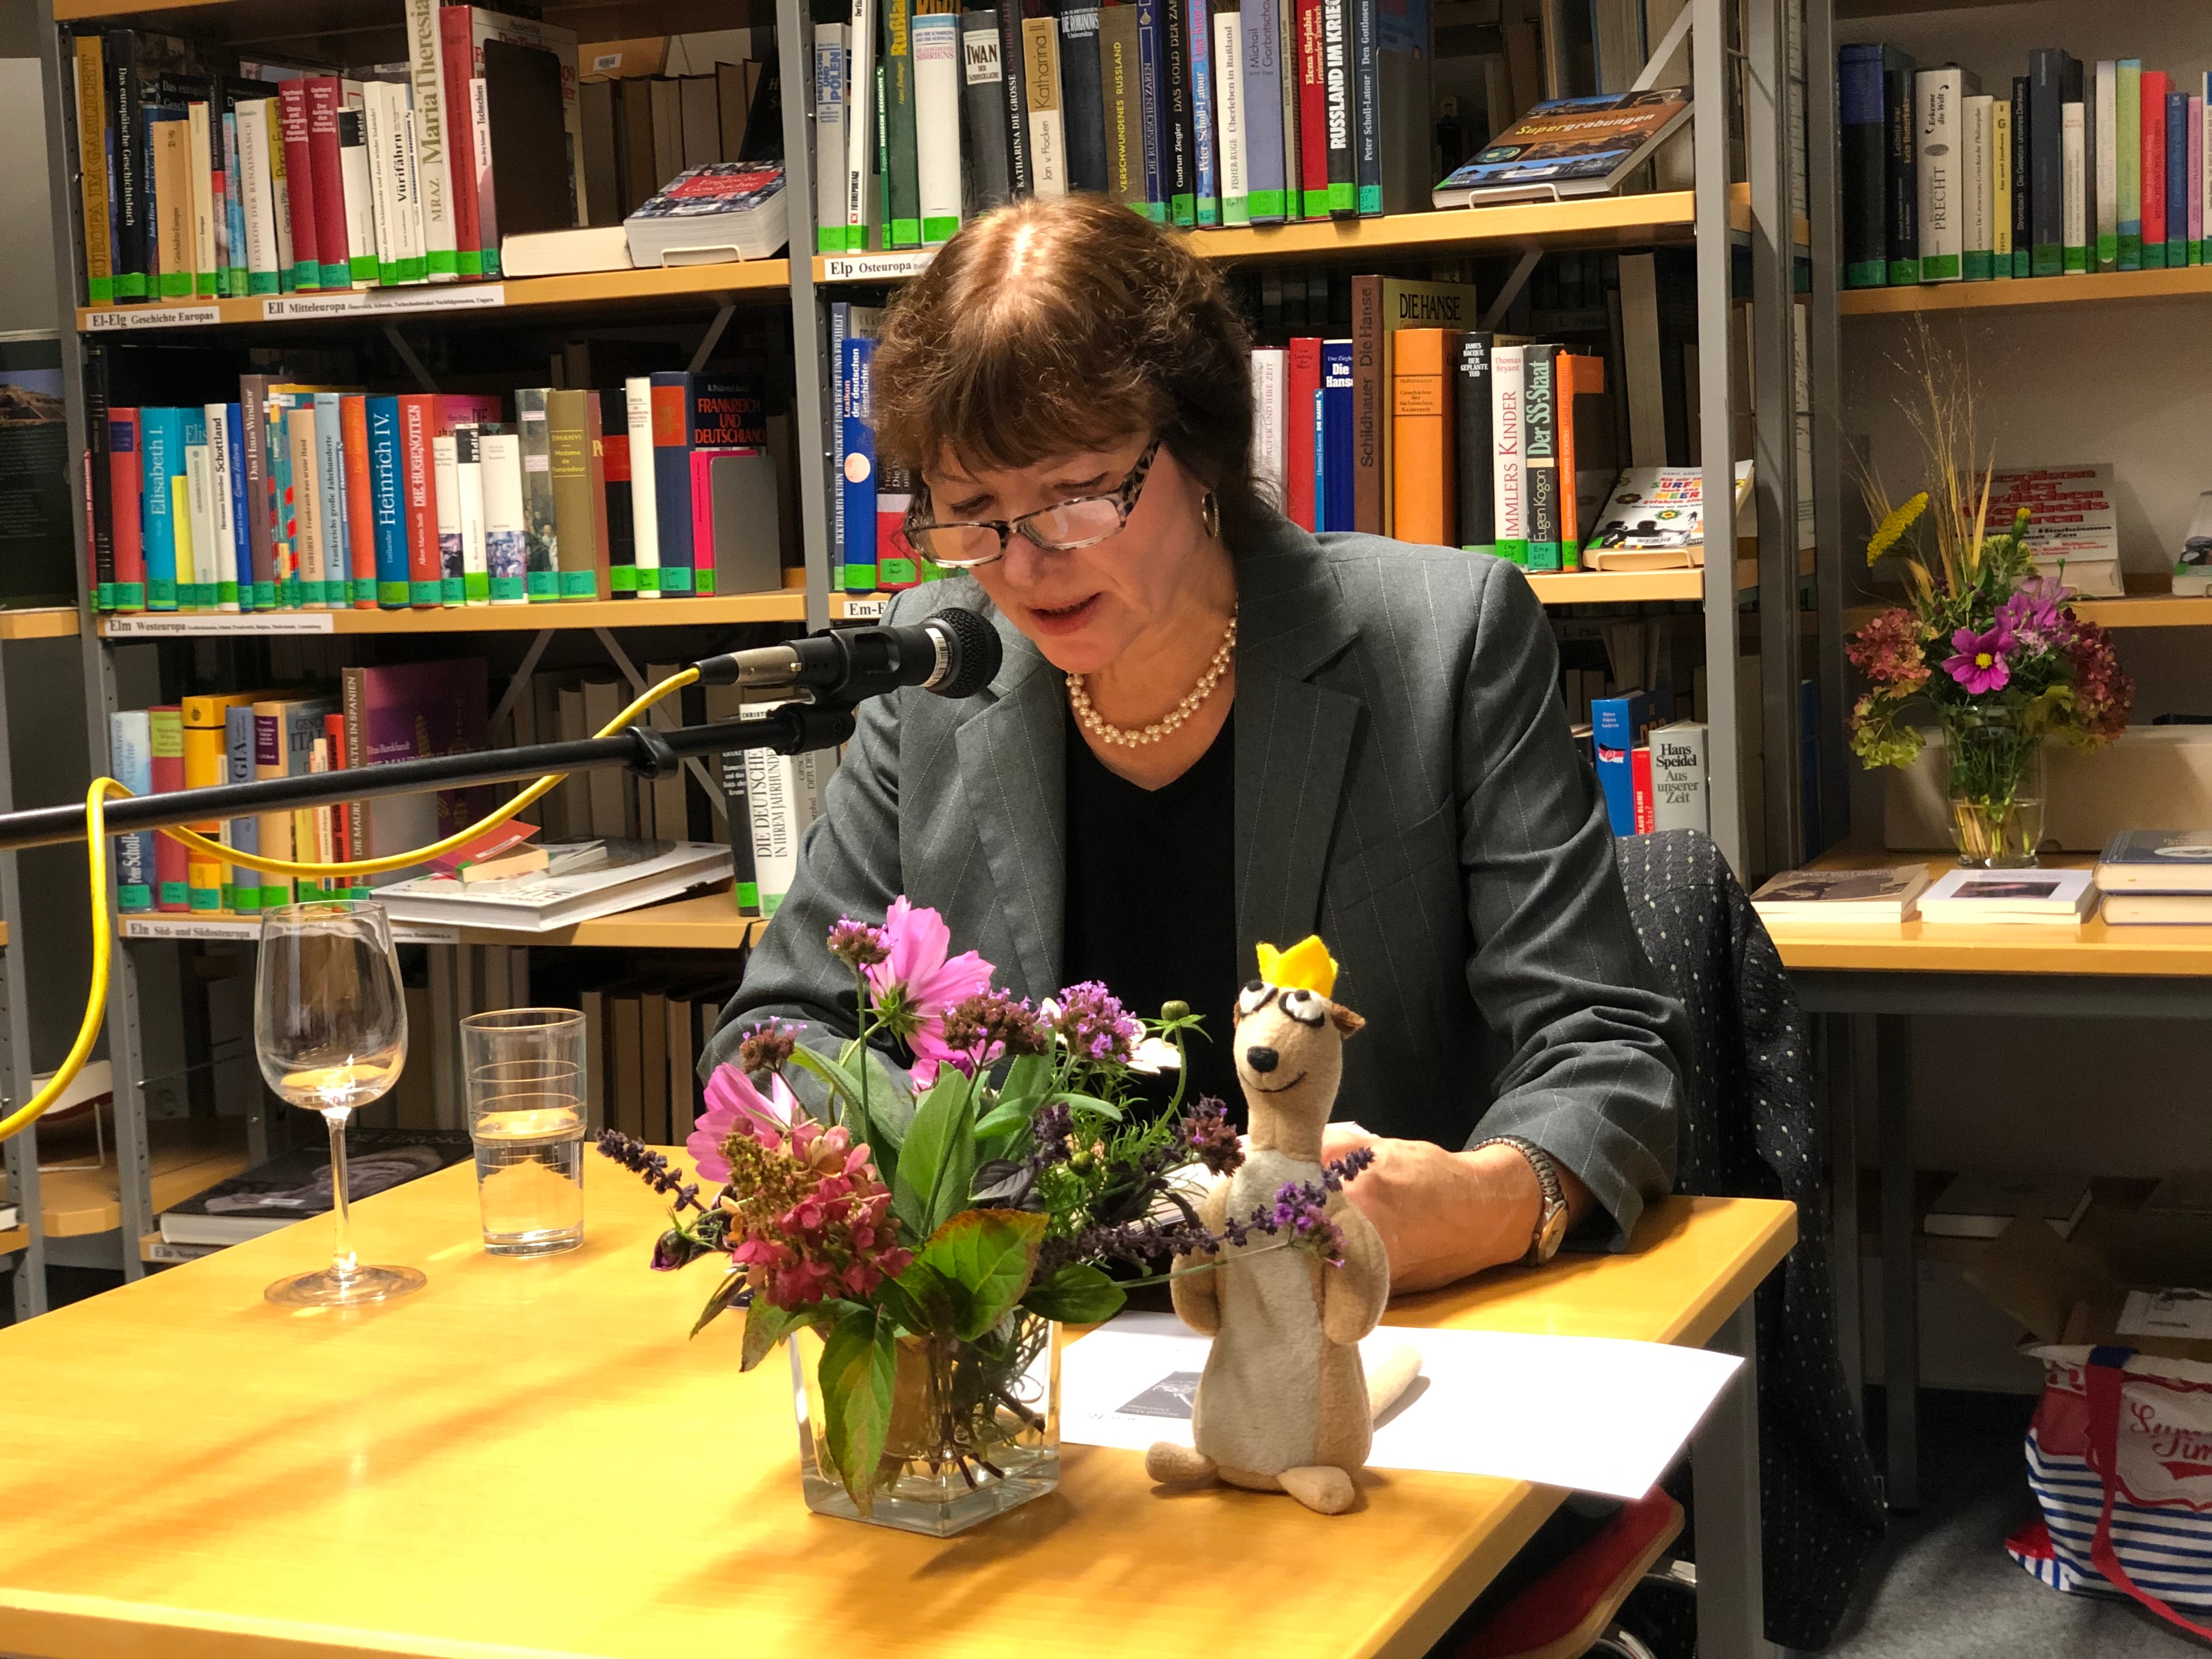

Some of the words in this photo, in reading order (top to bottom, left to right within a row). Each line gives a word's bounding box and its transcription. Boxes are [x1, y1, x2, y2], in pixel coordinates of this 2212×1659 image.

[1169, 0, 1178, 21] ZAR
[1359, 1, 1370, 44] Gottlosen
[1029, 21, 1046, 33] II.
[1067, 30, 1093, 40] Universitas
[1170, 23, 1179, 48] DER
[1303, 9, 1314, 54] Skrjabin
[411, 0, 437, 94] Theresia
[916, 52, 954, 61] SIBIRIENS
[966, 44, 998, 65] IWAN
[1224, 26, 1233, 67] Rußland
[1248, 27, 1260, 69] Michail
[1326, 44, 1344, 67] IM
[1361, 46, 1370, 65] Den
[119, 67, 127, 86] Das
[830, 52, 842, 101] POLEN
[1031, 35, 1051, 110] Katharina
[1113, 41, 1124, 95] RUSSLAND
[1142, 61, 1152, 100] ZAREN
[1170, 50, 1181, 86] GOLD
[1226, 69, 1234, 80] in
[1306, 55, 1314, 86] Elena
[1173, 88, 1183, 113] DAS
[1195, 72, 1208, 142] Scholl-Latour
[1227, 82, 1237, 133] Überleben
[1328, 68, 1346, 150] RUSSLAND
[1361, 75, 1373, 136] Scholl-Latour
[1928, 93, 1936, 126] Erkenne
[1937, 93, 1945, 114] Welt
[119, 88, 128, 147] europäische
[357, 113, 365, 144] PIPER
[419, 94, 443, 165] Maria
[1144, 99, 1155, 157] RUSSISCHEN
[1515, 113, 1655, 136] Supergrabungen
[1937, 114, 1945, 125] die
[1040, 120, 1051, 155] Flocken
[1118, 99, 1128, 193] VERSCHWUNDENES
[1174, 122, 1183, 153] Ziegler
[1364, 137, 1373, 161] Peter
[245, 123, 257, 192] RENAISSANCE
[1045, 155, 1052, 163] v.
[1148, 159, 1156, 175] DIE
[1175, 155, 1184, 188] Gudrun
[1198, 146, 1210, 172] Peter
[1229, 138, 1239, 189] FISHER-RUGE
[87, 168, 103, 198] IM
[122, 149, 134, 226] Geschichtsbuch
[1042, 167, 1052, 182] Jan
[429, 178, 442, 223] MRAZ
[850, 171, 859, 211] FOTOREPORTAGE
[1933, 166, 1946, 231] PRECHT
[2016, 192, 2024, 231] Strombach
[89, 201, 106, 276] EUROPA
[250, 222, 261, 268] LEXIKON
[830, 261, 853, 278] Elp
[858, 262, 912, 273] Osteuropa
[92, 314, 127, 328] El-Elg
[131, 314, 176, 324] Geschichte
[178, 312, 214, 321] Europas
[268, 302, 284, 314] Ell
[289, 302, 346, 313] Mitteleuropa
[1358, 288, 1372, 338] Hanse
[1400, 293, 1419, 319] DIE
[1421, 295, 1462, 321] HANSE
[833, 313, 843, 356] FREIHEIT
[1465, 342, 1482, 351] JAMES
[834, 358, 843, 374] UND
[1332, 363, 1350, 375] Die
[1359, 341, 1373, 367] Die
[1460, 363, 1489, 371] GEPLANTE
[851, 348, 860, 399] deutschen
[1265, 362, 1273, 381] ZEIT
[1496, 365, 1520, 374] Bryant
[834, 375, 843, 403] RECHT
[1525, 360, 1551, 425] SS-Staat
[246, 388, 257, 430] Windsor
[697, 397, 760, 413] FRANKREICH
[834, 404, 843, 423] UND
[851, 401, 860, 418] der
[1265, 404, 1273, 427] UND
[149, 425, 163, 435] I.
[695, 427, 765, 444] DEUTSCHLAND
[719, 413, 741, 428] UND
[1359, 377, 1374, 467] Schildhauer
[1498, 391, 1517, 457] KINDER
[212, 417, 225, 472] Schottland
[247, 431, 257, 459] Haus
[470, 431, 479, 462] PIPER
[835, 422, 844, 467] EINIGKEIT
[1526, 426, 1551, 455] Der
[149, 438, 166, 515] Elisabeth
[250, 461, 258, 481] Das
[326, 435, 335, 491] Jahrhunderte
[835, 472, 844, 494] KUHN
[1533, 469, 1550, 506] Kogon
[1654, 492, 1701, 500] MEER
[328, 493, 338, 517] große
[1504, 463, 1520, 538] IMMLERS
[836, 495, 844, 544] EKKEHARD
[1533, 507, 1551, 542] Eugen
[329, 526, 340, 568] Frankreichs
[347, 676, 358, 722] SPANIEN
[349, 724, 358, 735] IN
[348, 735, 359, 769] ULTUR
[1656, 755, 1697, 770] Speidel
[1660, 743, 1692, 755] Hans
[748, 749, 770, 828] DEUTSCHE
[766, 748, 787, 809] JAHRHUNDE
[806, 770, 815, 790] DER
[1657, 782, 1700, 793] unserer
[1665, 770, 1688, 782] Aus
[1666, 792, 1691, 804] Zeit
[771, 811, 787, 844] IHREM
[755, 832, 772, 858] DIE
[775, 846, 788, 858] IN
[127, 867, 142, 884] Peter
[153, 924, 173, 935] Süd-
[174, 927, 191, 936] und
[193, 927, 250, 938] Südosteuropa
